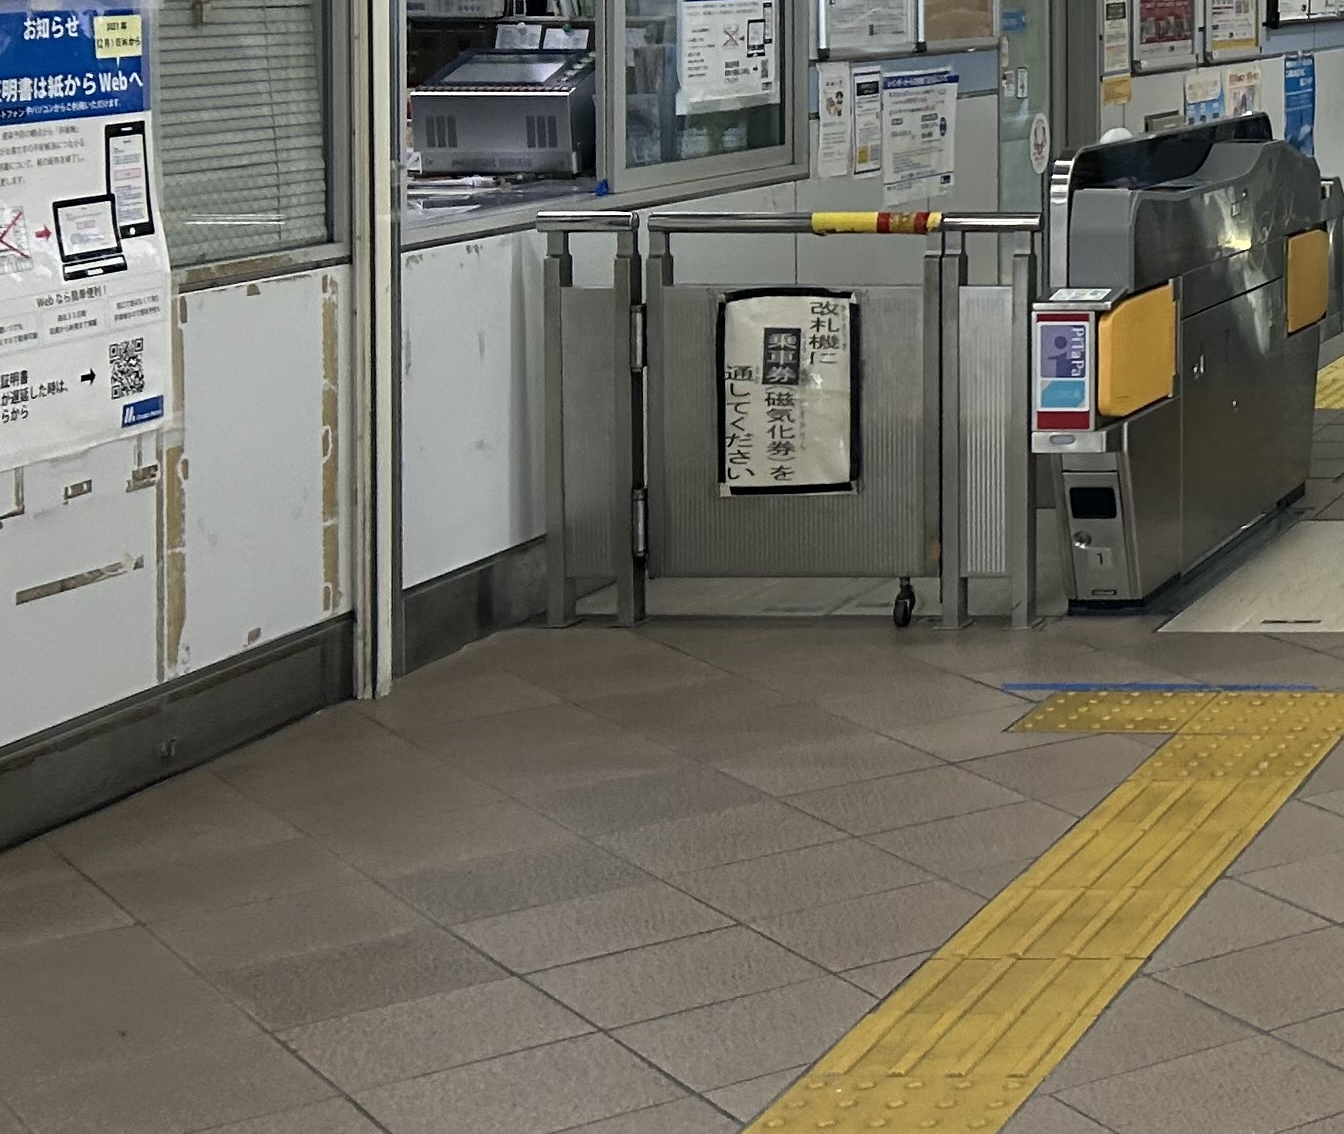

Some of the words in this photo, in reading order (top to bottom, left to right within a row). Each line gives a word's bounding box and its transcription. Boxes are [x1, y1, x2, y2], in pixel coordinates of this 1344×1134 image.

[23, 16, 80, 40] お知らせ
[0, 70, 144, 103] 明書は紙からWebへ
[808, 300, 840, 365] 改札機に
[1071, 327, 1085, 377] PiTaPa
[724, 365, 757, 482] 通してください
[1096, 552, 1104, 566] 1
